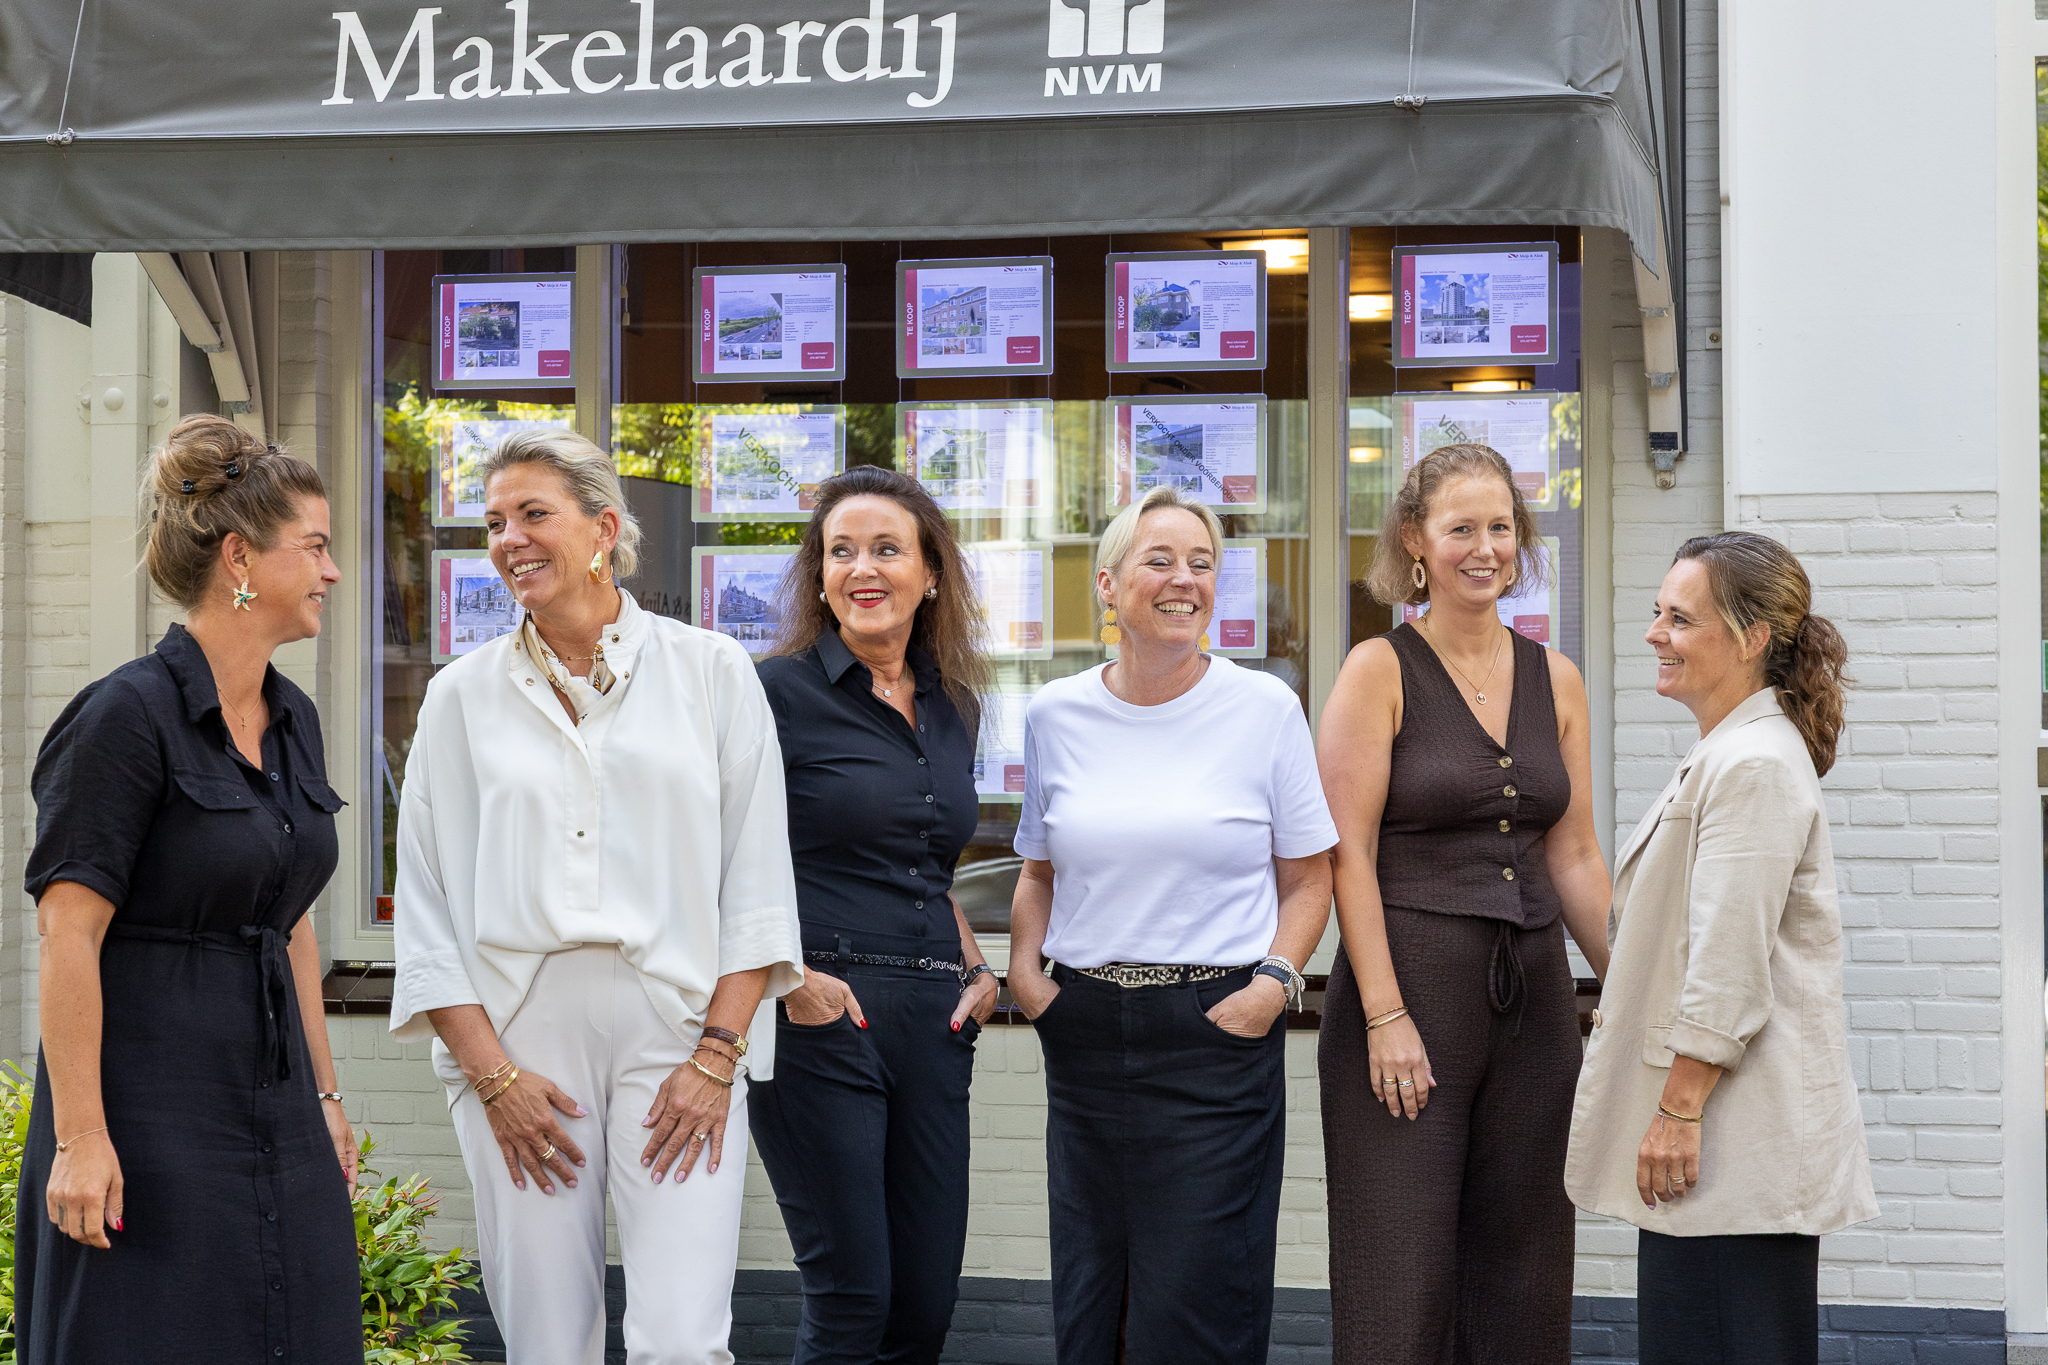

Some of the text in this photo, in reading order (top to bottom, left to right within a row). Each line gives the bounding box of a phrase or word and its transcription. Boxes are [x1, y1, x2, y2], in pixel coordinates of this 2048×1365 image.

[321, 0, 956, 108] Makelaardij
[1044, 63, 1162, 97] NVM
[1404, 314, 1411, 324] TE
[1118, 320, 1124, 330] TE
[907, 326, 913, 336] TE
[704, 332, 711, 342] TE
[444, 338, 451, 348] TE
[463, 423, 488, 451] VERKOCH
[1143, 408, 1175, 440] VERKOCHT
[1174, 440, 1196, 463] ONDER
[1195, 461, 1237, 503] VOORBEHOUD
[738, 427, 805, 497] VERKOCHT
[1120, 462, 1127, 472] TE
[1403, 461, 1410, 470] TE
[702, 471, 708, 481] TE
[906, 468, 913, 476] TE
[444, 476, 450, 485] TE
[441, 613, 447, 623] TE
[704, 611, 710, 621] TE
